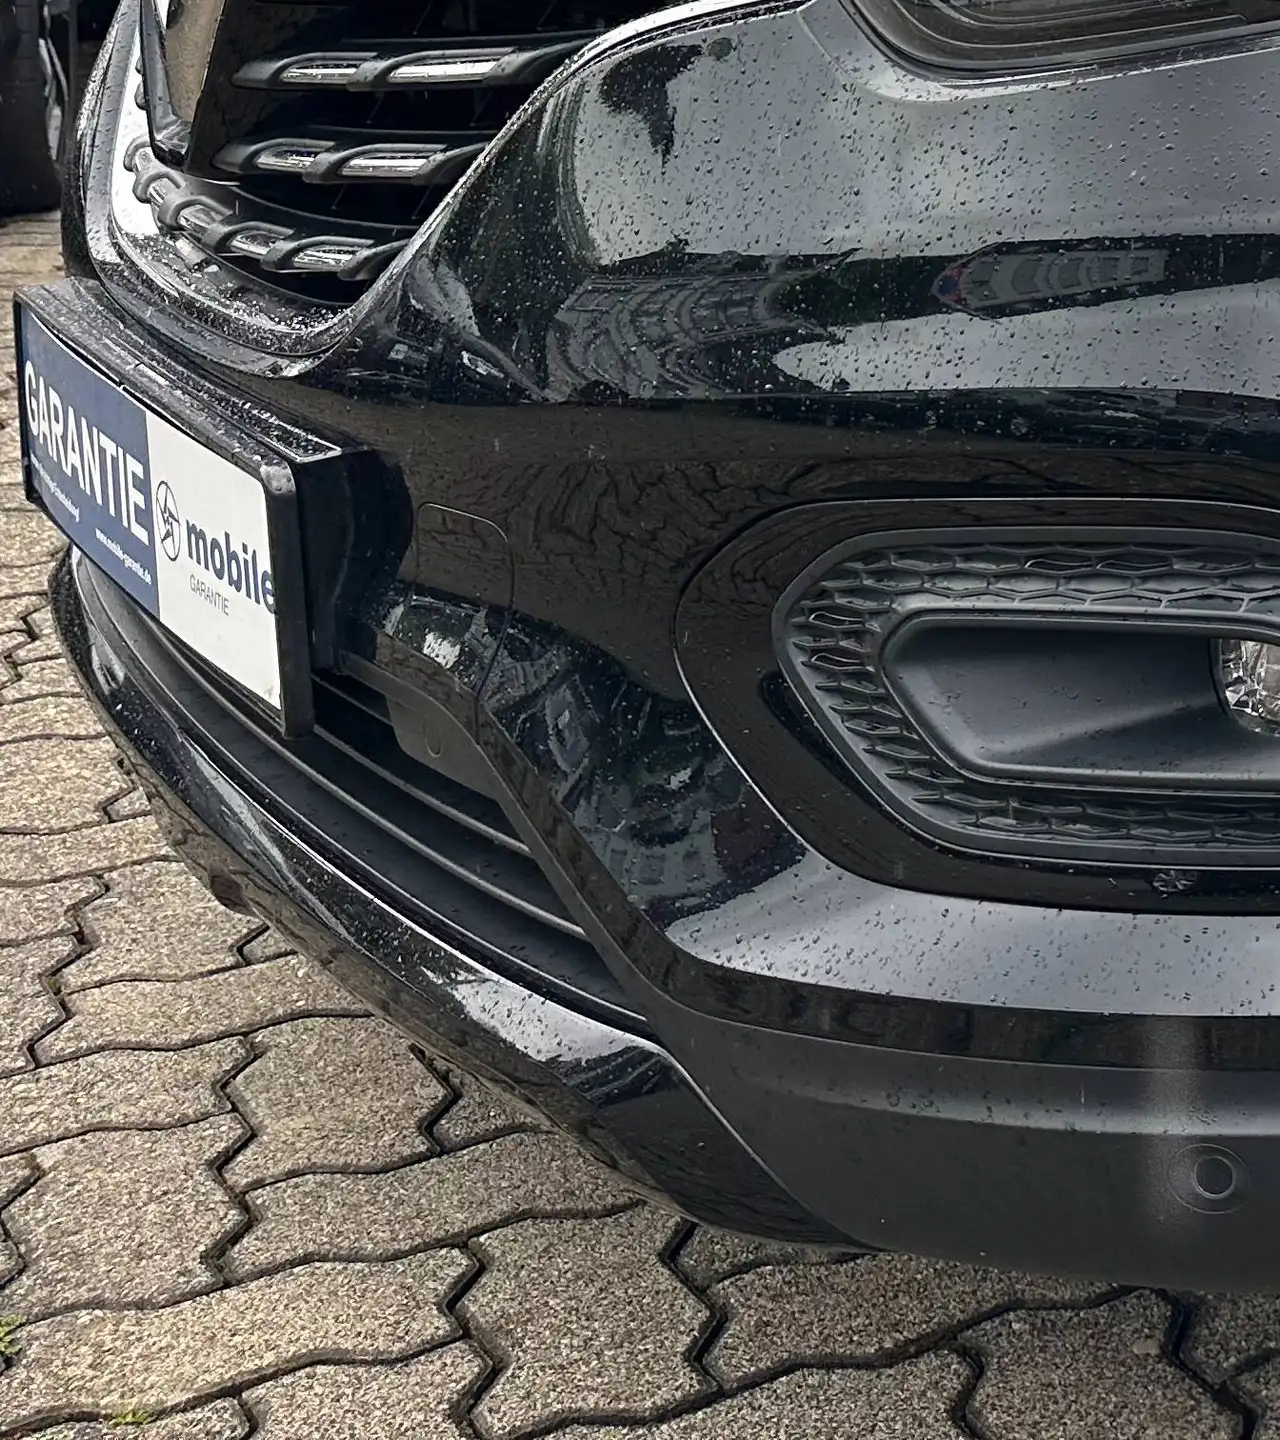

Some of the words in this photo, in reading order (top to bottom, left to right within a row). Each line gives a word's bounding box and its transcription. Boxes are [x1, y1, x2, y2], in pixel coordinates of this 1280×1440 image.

[24, 360, 150, 546] GARANTIE
[186, 518, 276, 615] mobile
[190, 574, 229, 616] GARANTIE
